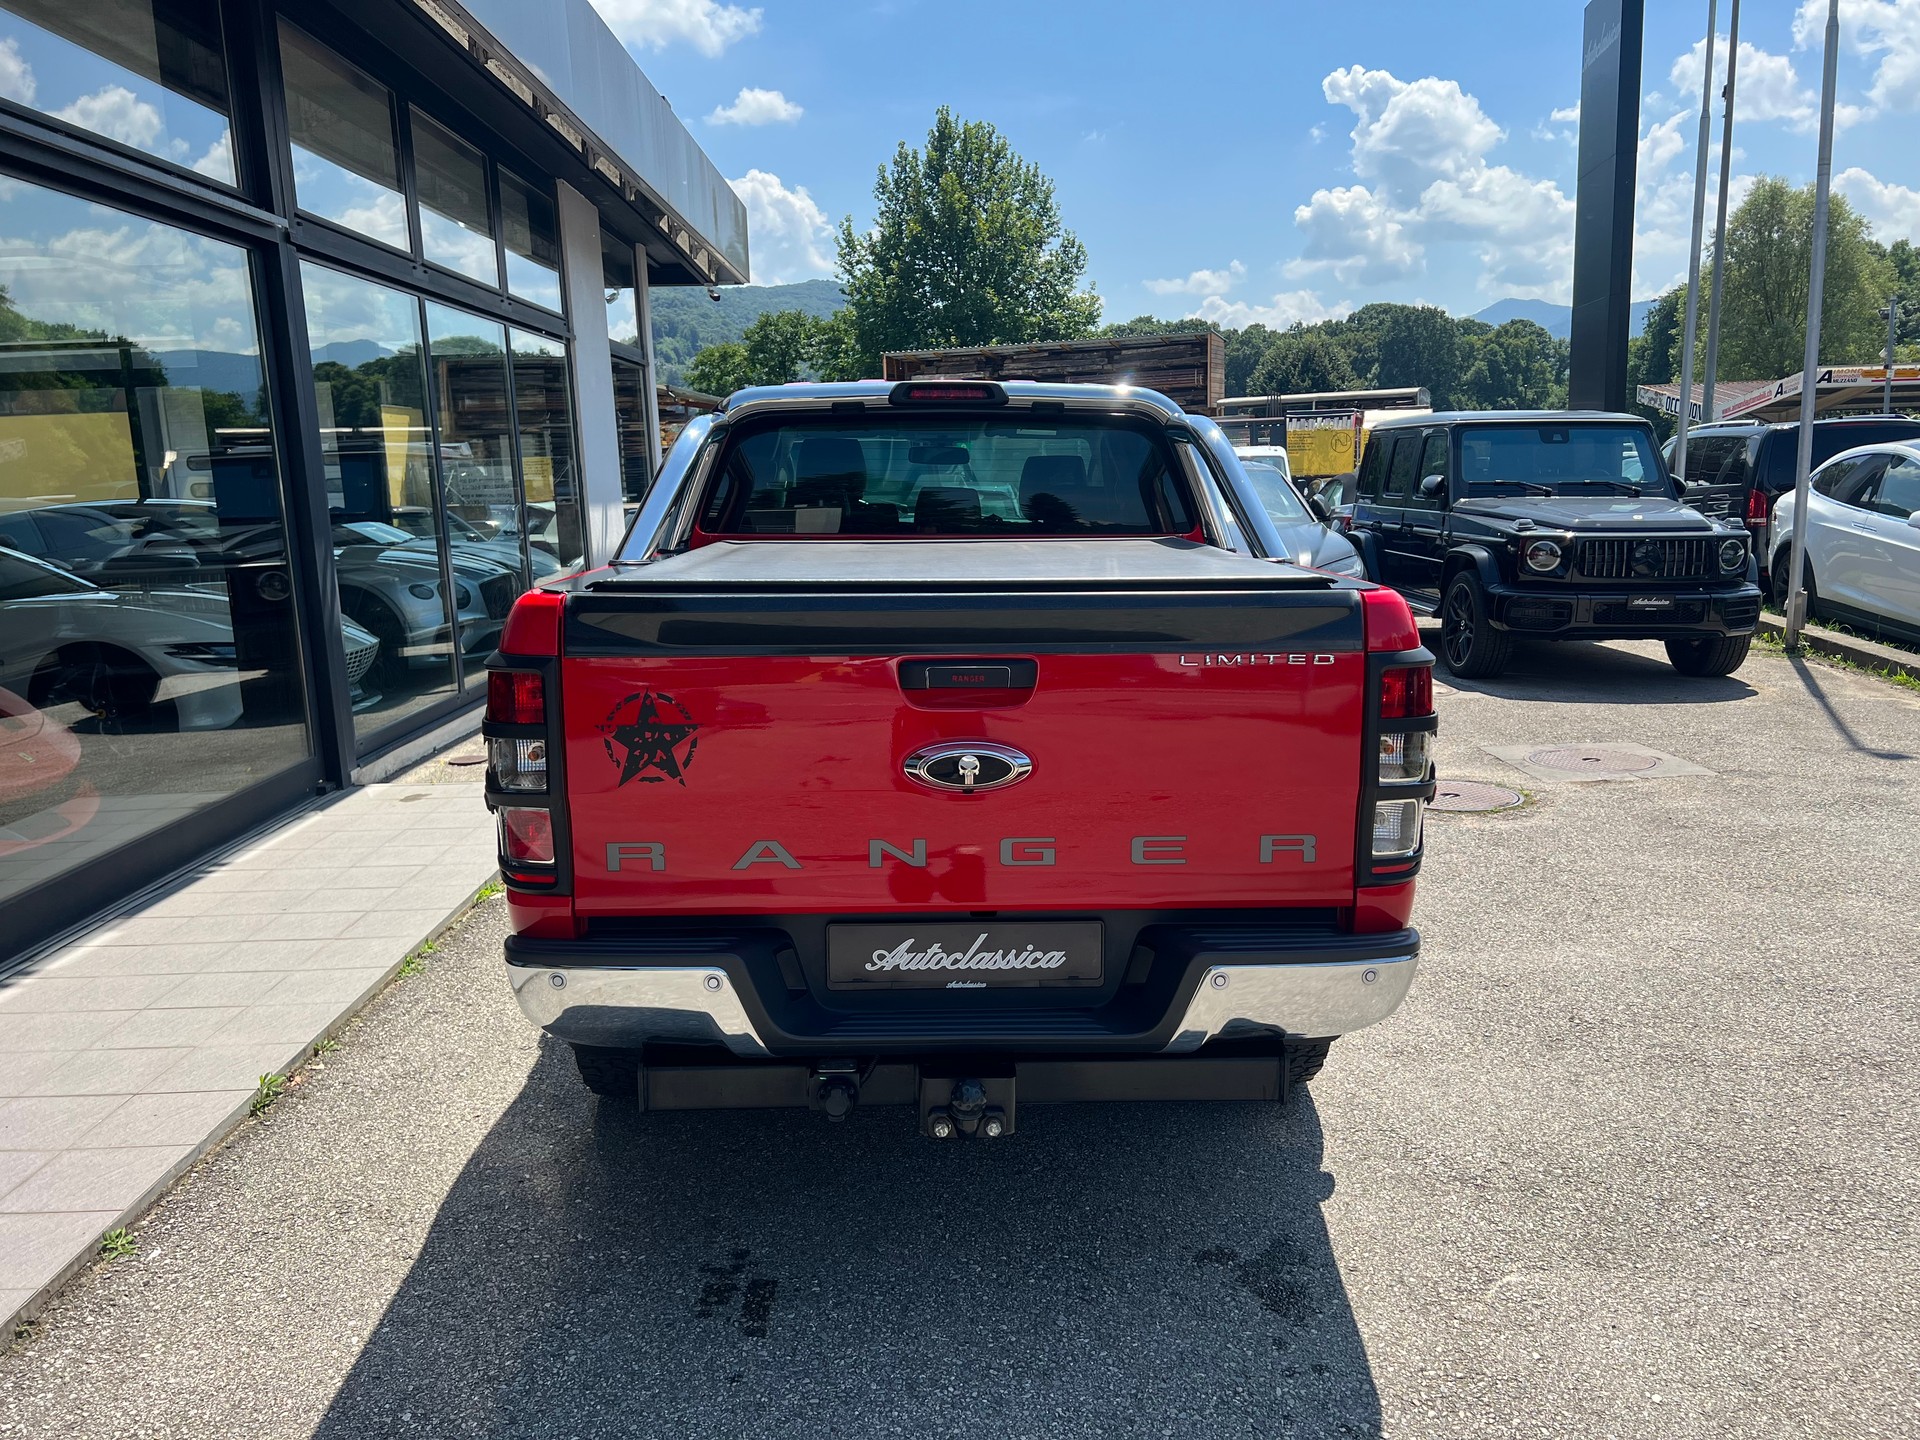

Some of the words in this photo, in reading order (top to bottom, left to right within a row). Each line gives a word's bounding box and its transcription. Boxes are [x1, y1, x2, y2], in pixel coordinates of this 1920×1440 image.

[1179, 653, 1335, 666] LIMITED
[951, 674, 985, 682] RANGER
[605, 834, 1317, 872] RANGER
[865, 933, 1066, 971] Autoclassica
